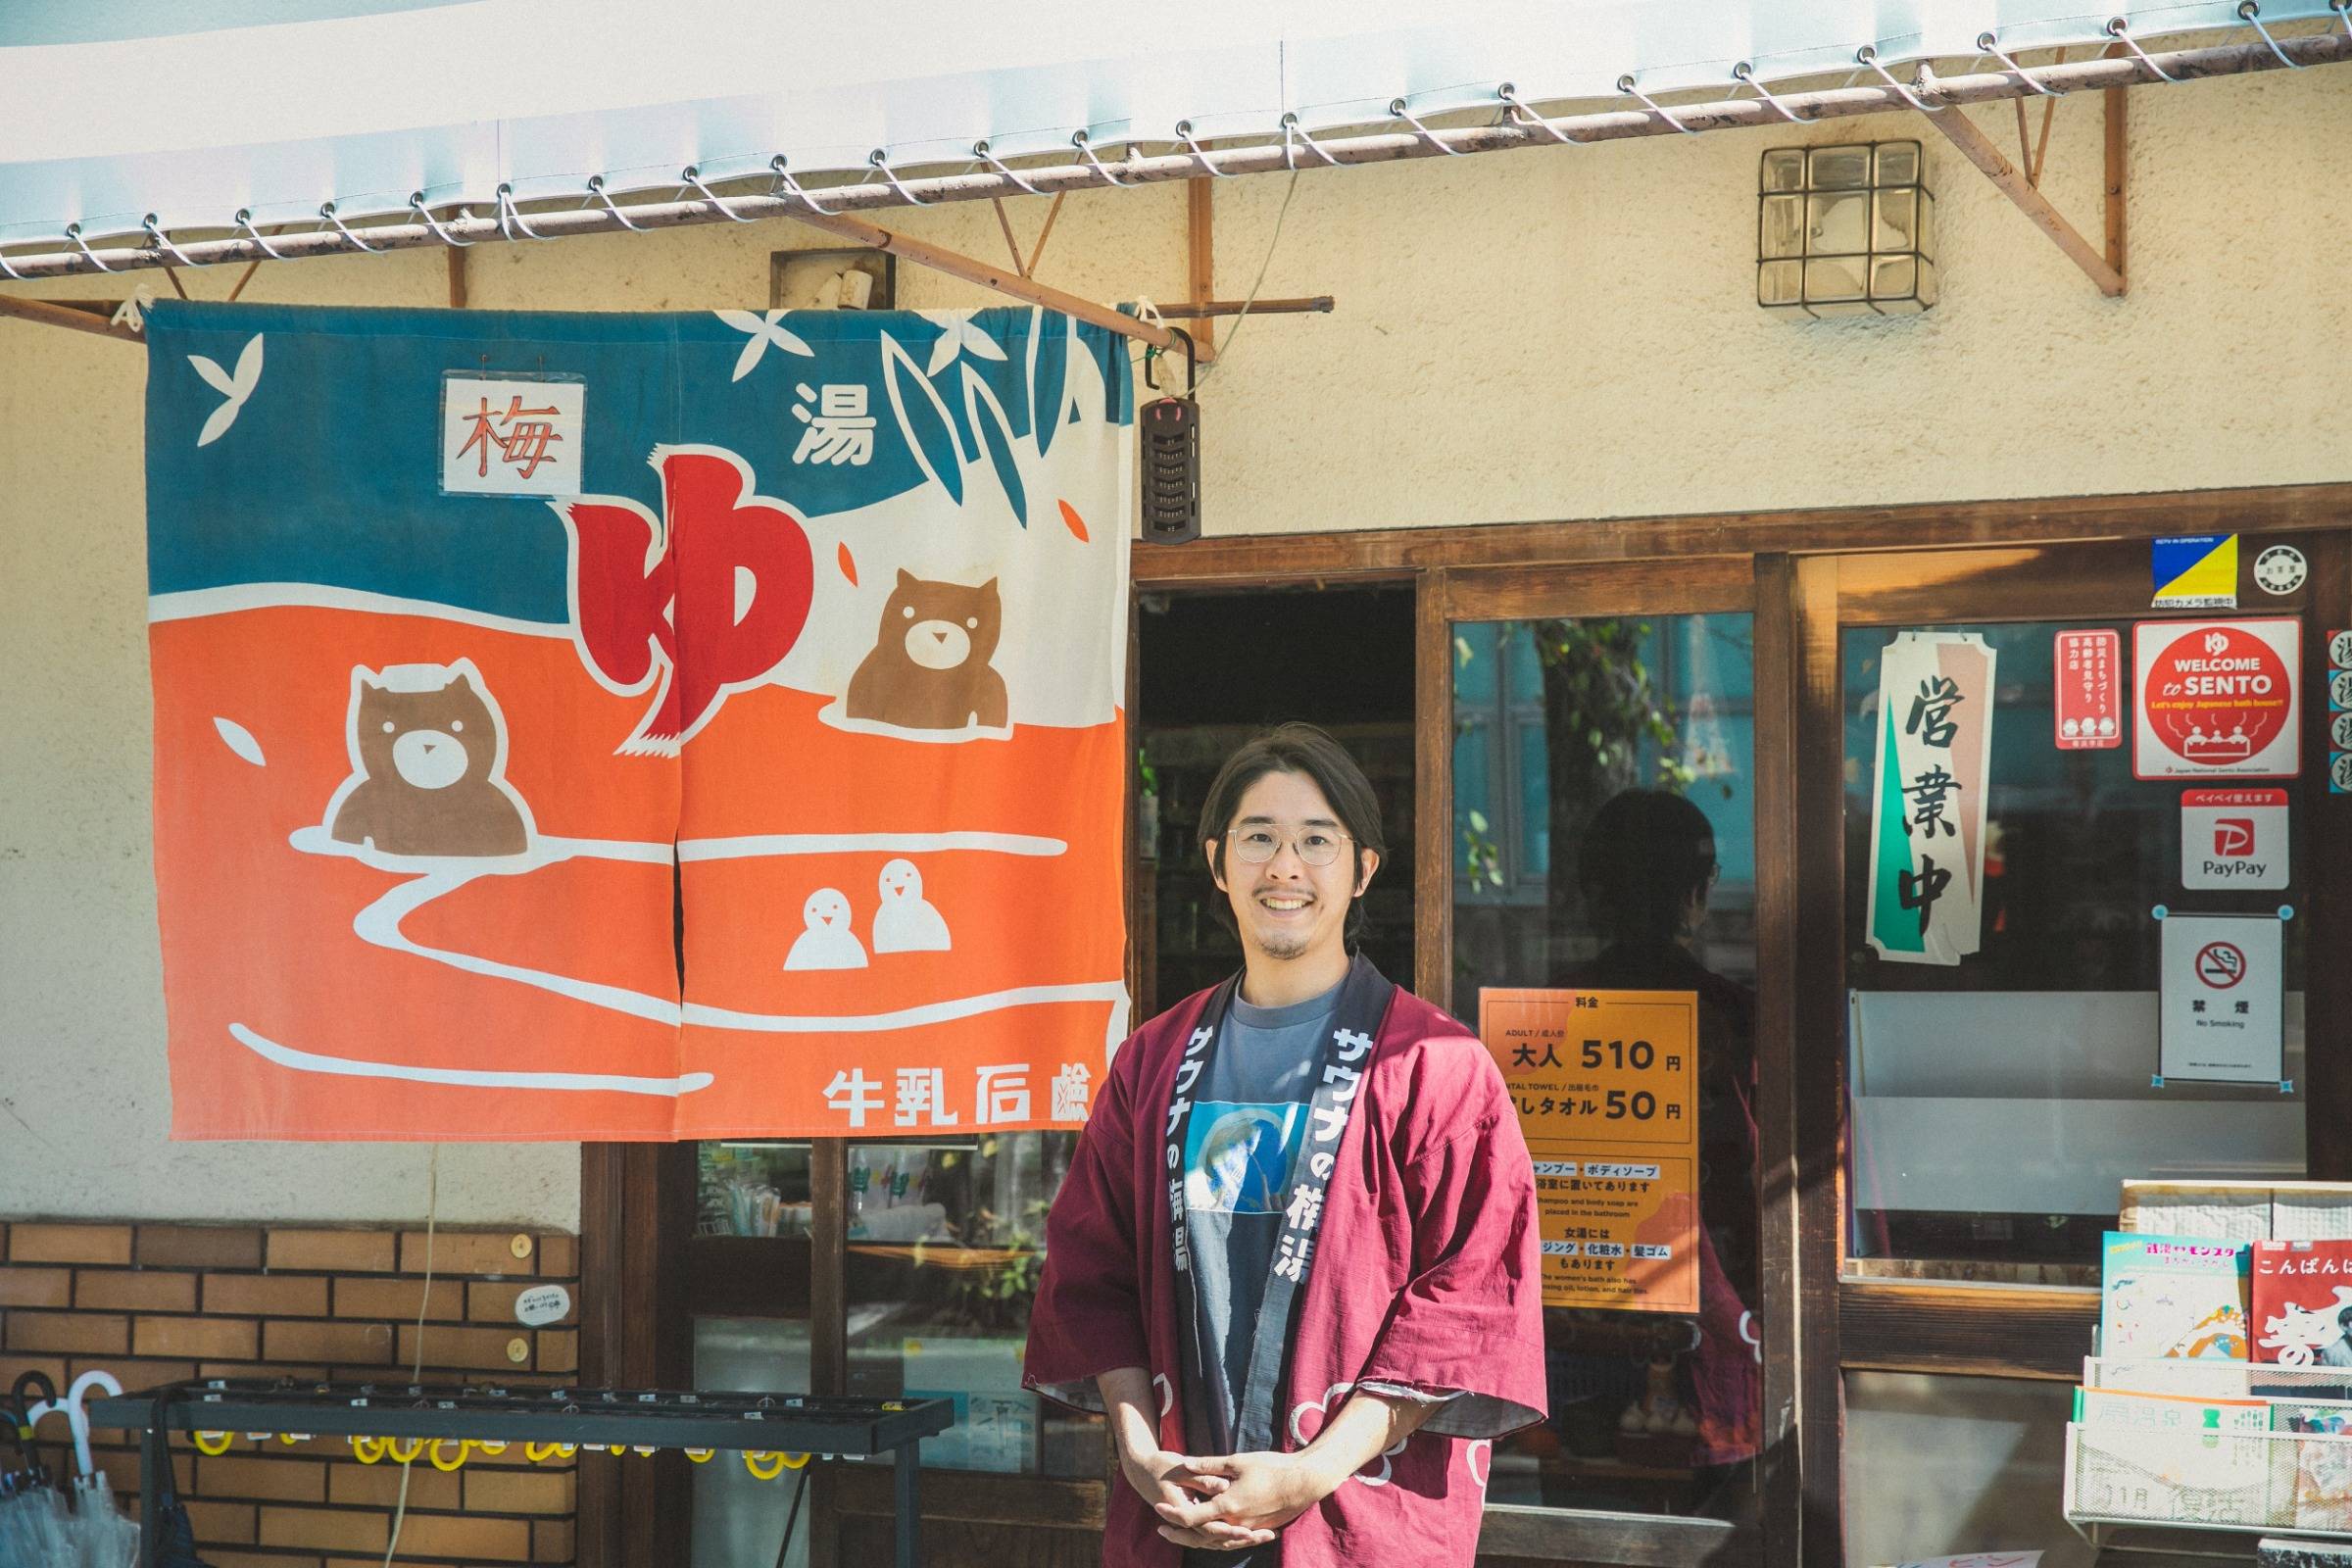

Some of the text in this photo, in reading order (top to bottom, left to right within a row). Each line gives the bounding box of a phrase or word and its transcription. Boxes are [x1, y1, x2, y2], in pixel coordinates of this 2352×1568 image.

[791, 382, 877, 466] 湯
[456, 395, 564, 479] 梅
[565, 454, 814, 742] ゆ
[2205, 632, 2230, 656] ゆ
[2174, 658, 2261, 672] WELCOME
[2162, 674, 2273, 696] to SENTO
[1898, 674, 1965, 938] 営業中
[2195, 794, 2274, 803] ペイペイ使えます
[2203, 860, 2267, 878] PayPay
[1575, 996, 1598, 1008] 料金
[2192, 1000, 2249, 1014] 禁煙
[2196, 1019, 2245, 1030] No Smoking
[1512, 1040, 1681, 1071] 大人 510 円
[1506, 1082, 1527, 1091] NTAL
[1510, 1090, 1681, 1120] しタオル 50 円
[1564, 1227, 1610, 1239] 女湯には
[1560, 1258, 1615, 1271] もあります
